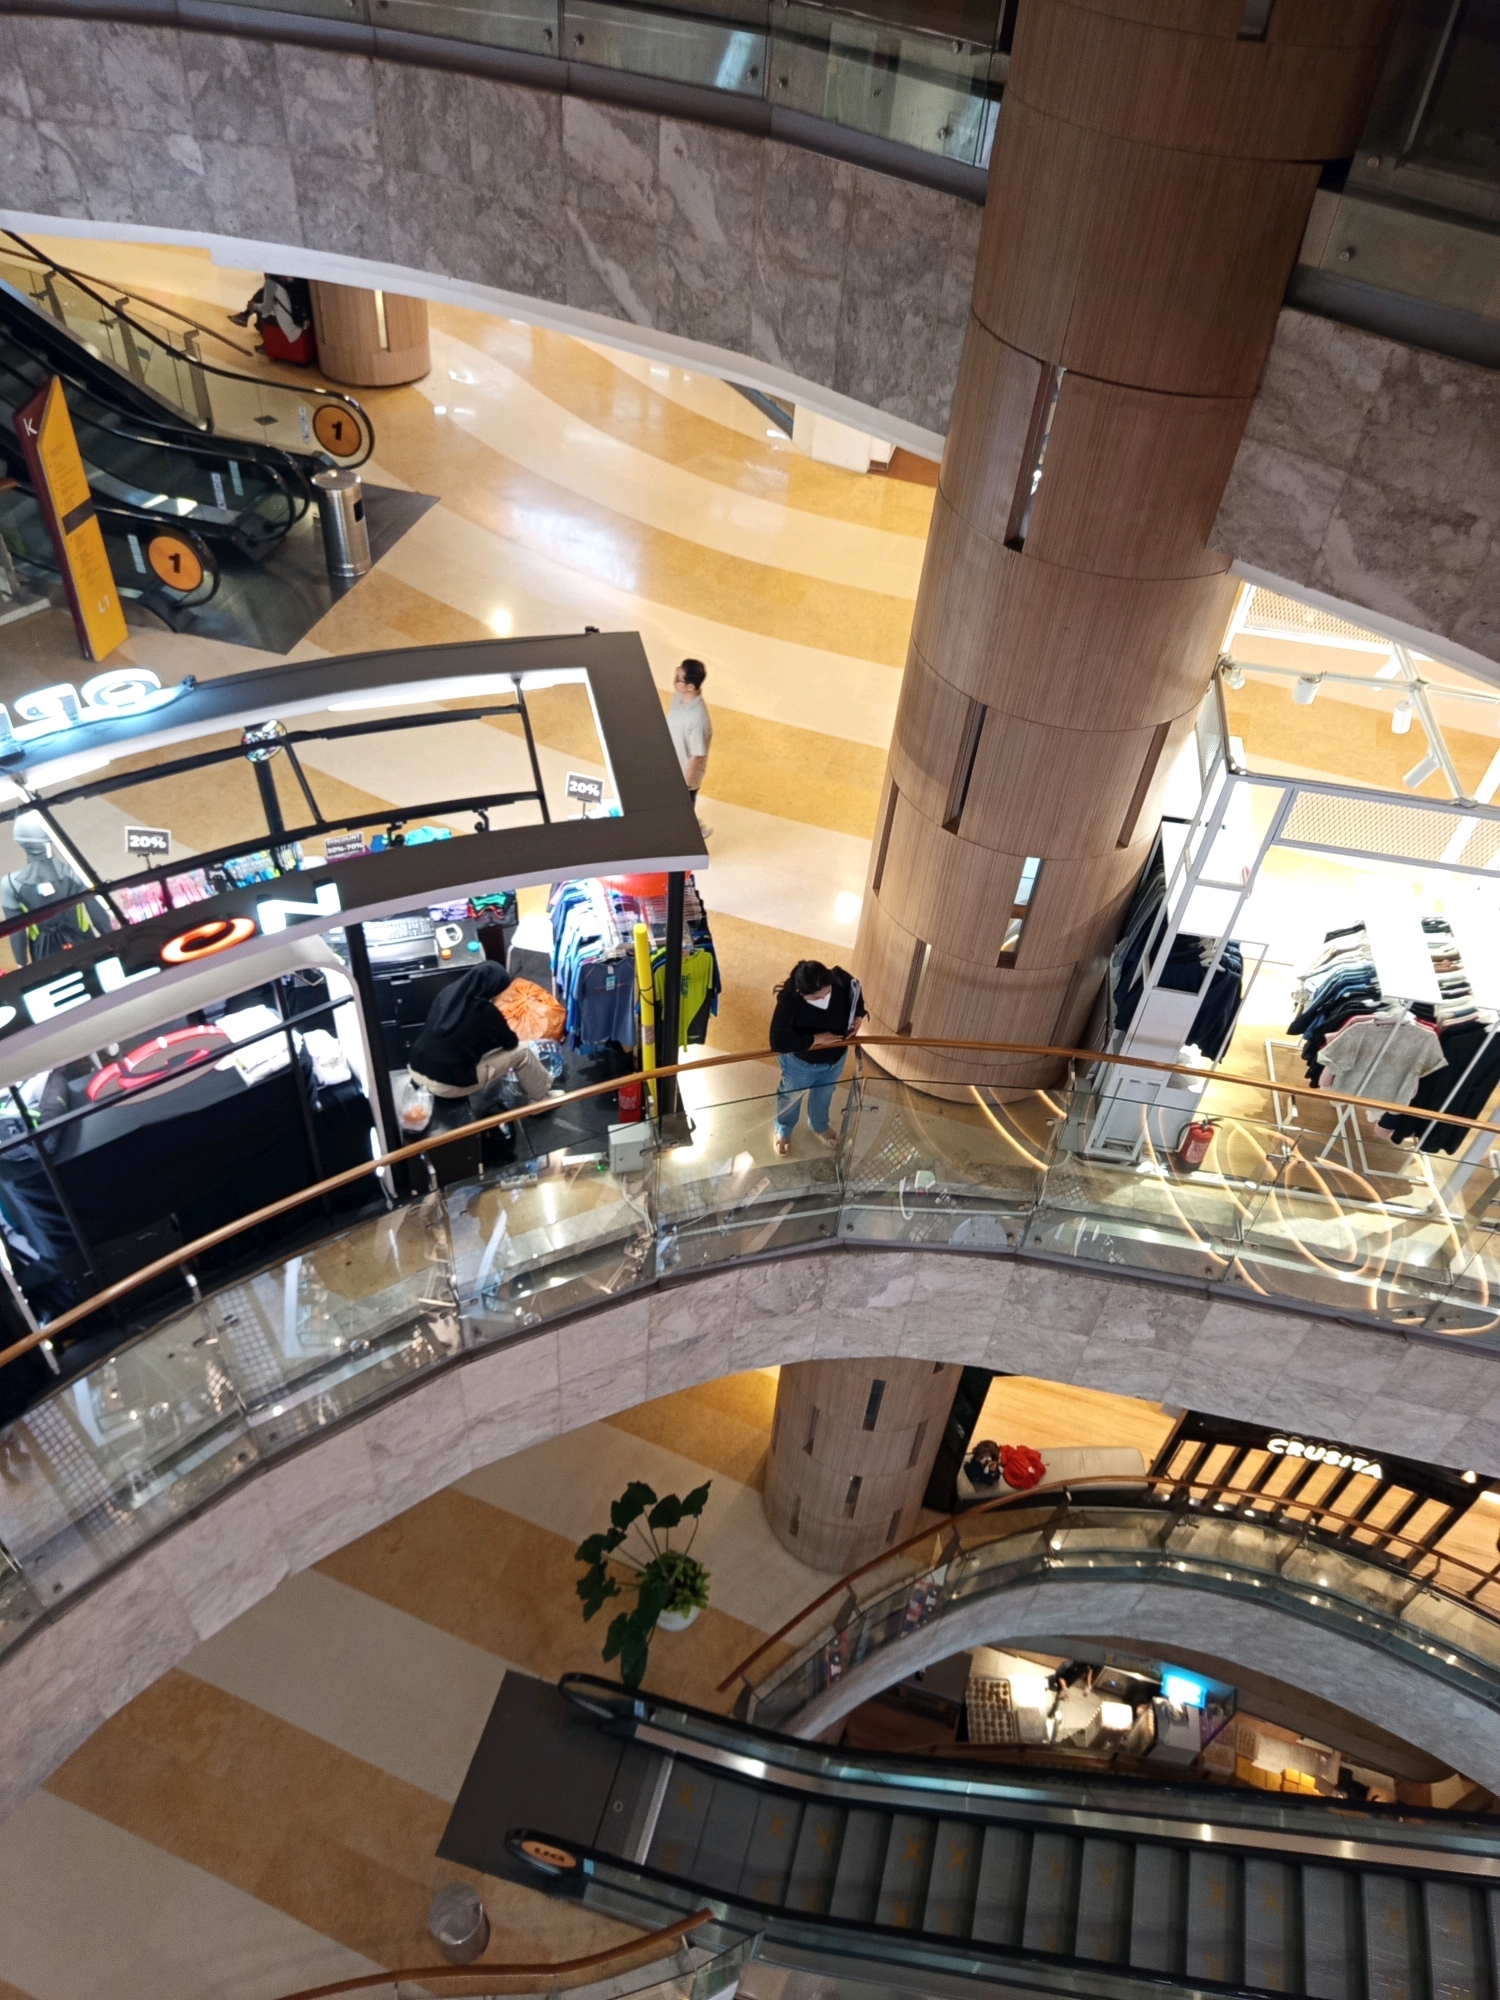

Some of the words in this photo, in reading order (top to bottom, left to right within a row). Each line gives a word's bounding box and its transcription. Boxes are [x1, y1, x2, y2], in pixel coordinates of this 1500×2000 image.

[22, 417, 38, 436] K
[331, 420, 344, 441] 1
[168, 552, 182, 574] 1
[569, 780, 600, 797] 20%
[128, 834, 166, 850] 20%
[0, 881, 342, 1029] ELON
[1266, 1438, 1383, 1480] CRUSITA
